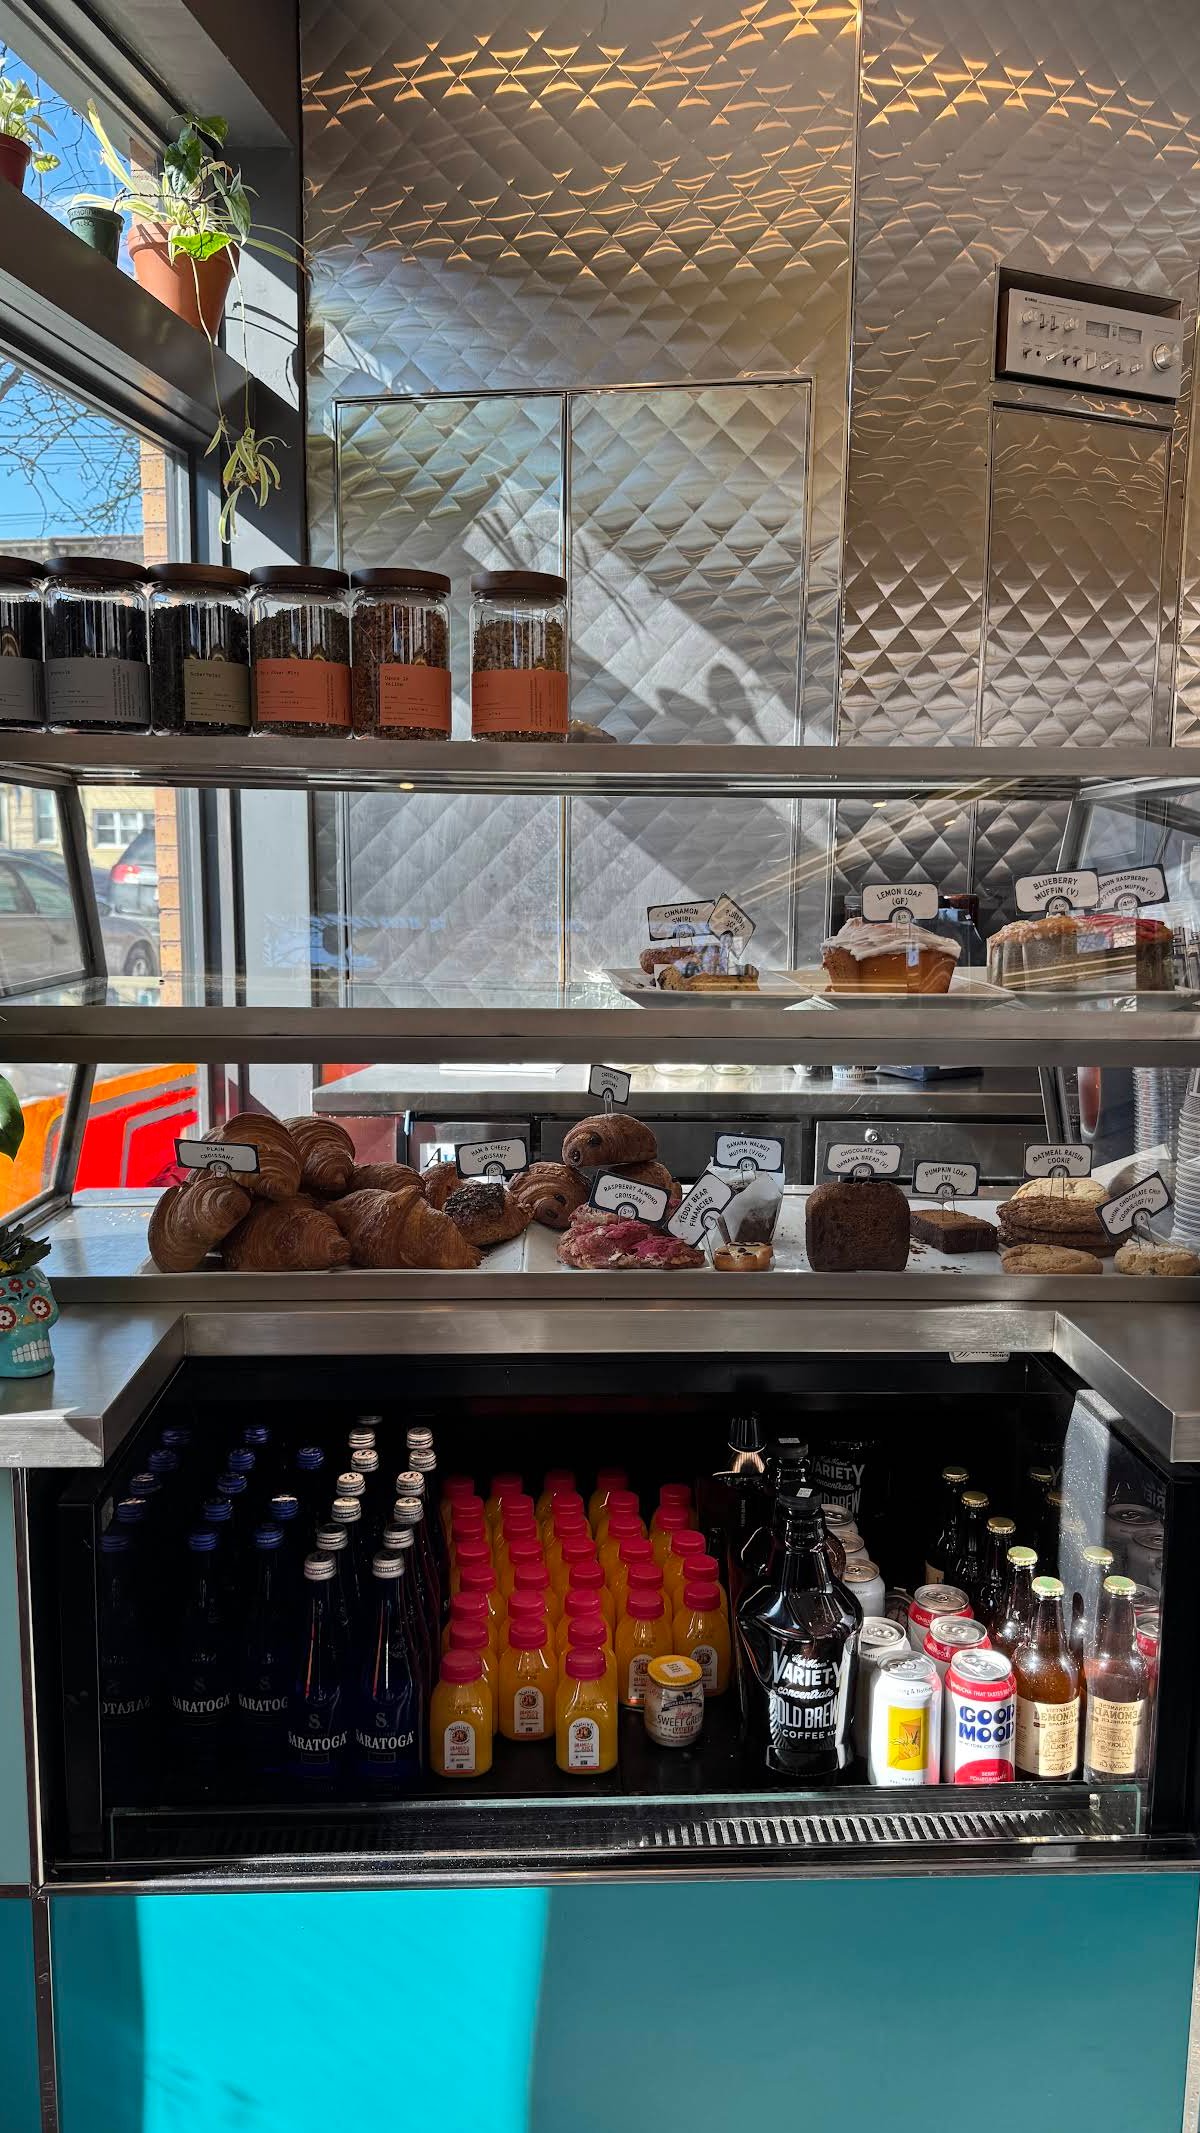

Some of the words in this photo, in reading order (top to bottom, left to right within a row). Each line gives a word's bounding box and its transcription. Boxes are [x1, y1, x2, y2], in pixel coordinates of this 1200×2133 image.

[1033, 877, 1078, 890] BLUEBERRY
[1099, 879, 1114, 890] EMON
[1124, 884, 1145, 893] MUFFIN
[876, 888, 901, 901] LEMON
[904, 888, 923, 897] LOAF
[1034, 886, 1063, 901] MUFFIN
[1066, 886, 1079, 897] (V)
[892, 897, 908, 906] (GF)
[664, 908, 699, 919] CINNAMON
[672, 916, 692, 924] SWIRL
[726, 1140, 748, 1149] BANANA
[750, 1141, 770, 1152] WALNUT
[840, 1148, 873, 1157] CHOCOLATE
[875, 1149, 888, 1157] CHIP
[471, 1149, 483, 1157] HAM
[477, 1153, 507, 1163] CROISSANT
[729, 1149, 748, 1157] MUFFIN
[1033, 1149, 1062, 1162] OATMEAL
[1064, 1149, 1084, 1162] RAISIN
[835, 1156, 859, 1169] BANANA
[861, 1155, 880, 1163] BREAD
[924, 1166, 952, 1177] PUMPKIN
[952, 1167, 968, 1178] LOAF
[603, 1183, 636, 1192] RASPBERRY
[636, 1187, 658, 1205] ALMOND
[614, 1192, 646, 1205] CROISSANT
[679, 1202, 693, 1224] TEDDY
[690, 1187, 708, 1203] BEAR
[689, 1196, 714, 1227] FINANCIER
[1108, 1206, 1121, 1224] TAHINI
[1119, 1189, 1148, 1208] CHOCOLATE
[1120, 1203, 1135, 1222] COOKIE
[777, 1686, 834, 1700] concentrate
[172, 1694, 230, 1713] SARATOGA
[238, 1692, 288, 1713] SARATOG
[804, 1696, 840, 1729] BREW
[959, 1703, 1015, 1725] GOOD
[657, 1714, 684, 1727] SWEET
[782, 1729, 825, 1740] COFFEE
[958, 1721, 1014, 1743] MOOD
[287, 1729, 348, 1751] SARATOGA
[355, 1728, 414, 1750] SARATOGA
